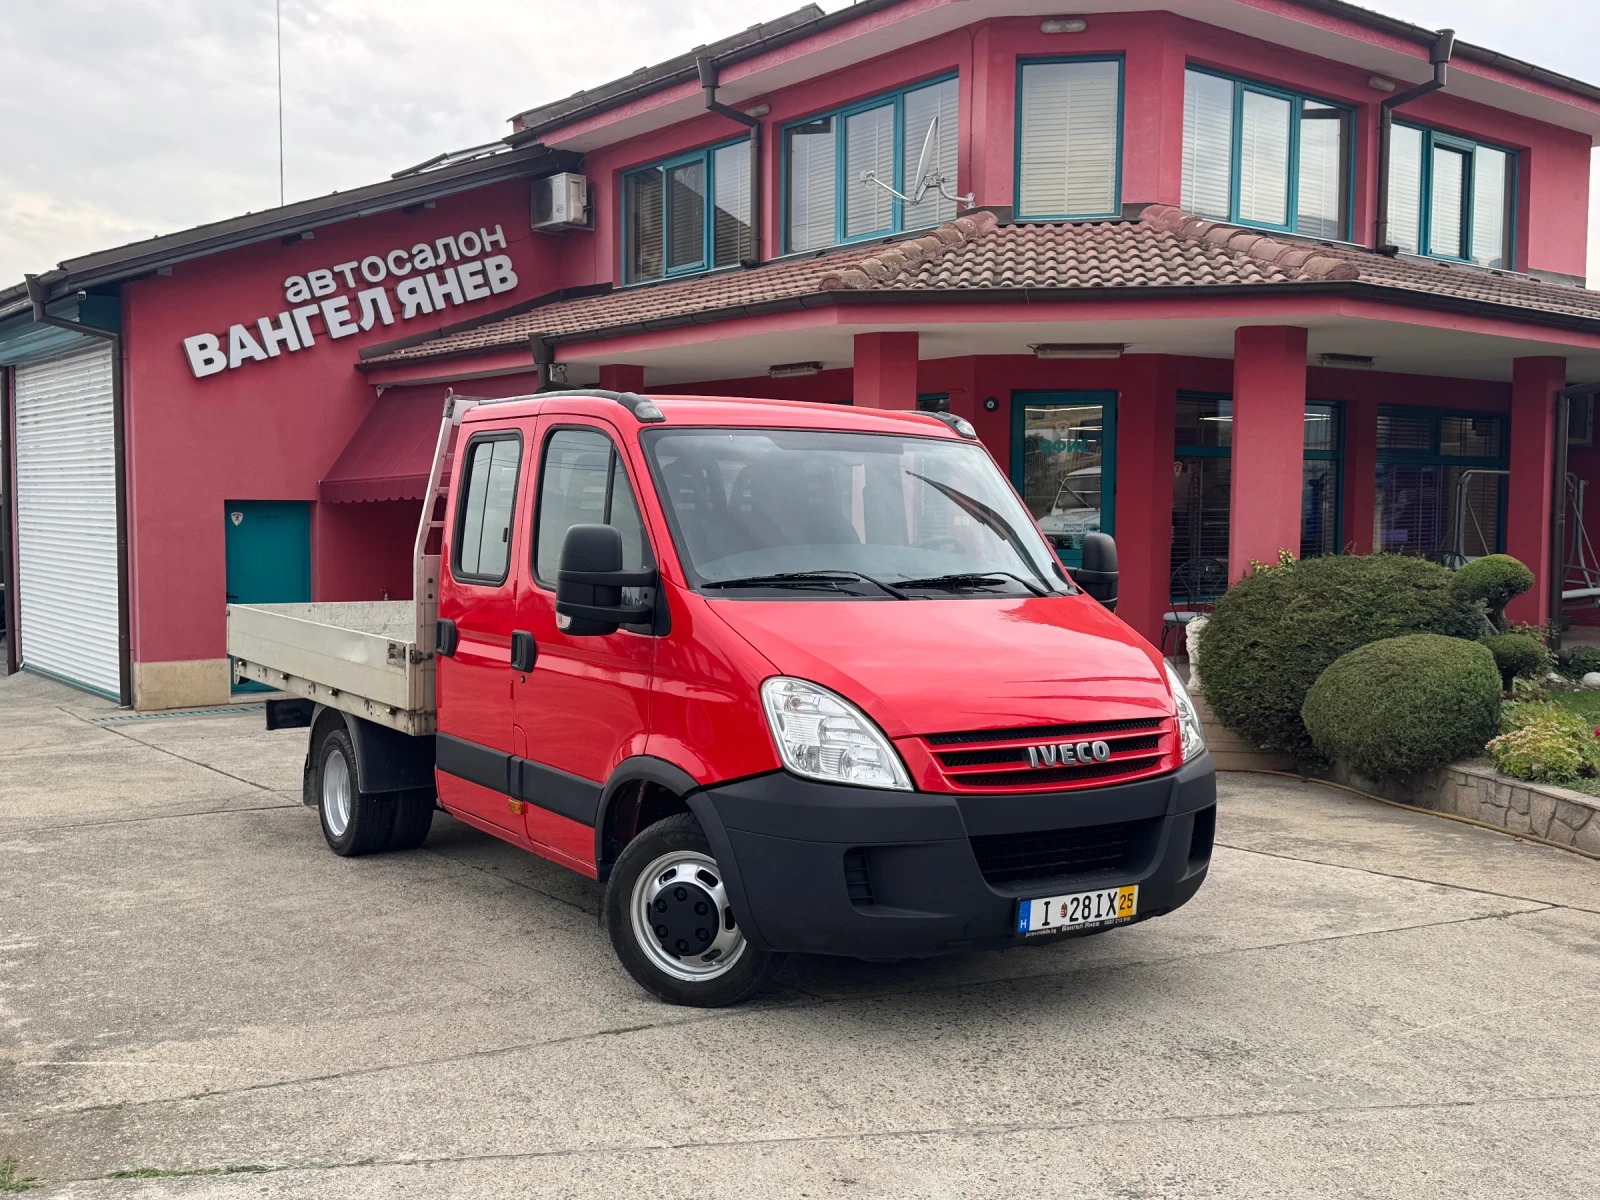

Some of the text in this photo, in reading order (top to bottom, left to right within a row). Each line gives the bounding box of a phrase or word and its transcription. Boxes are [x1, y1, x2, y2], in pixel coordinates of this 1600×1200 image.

[284, 224, 508, 304] автосалон
[183, 254, 519, 379] ВАНГЕЛ ЯНЕВ
[1026, 740, 1111, 769] IVECO
[1119, 892, 1134, 911] 25
[1019, 918, 1027, 929] H
